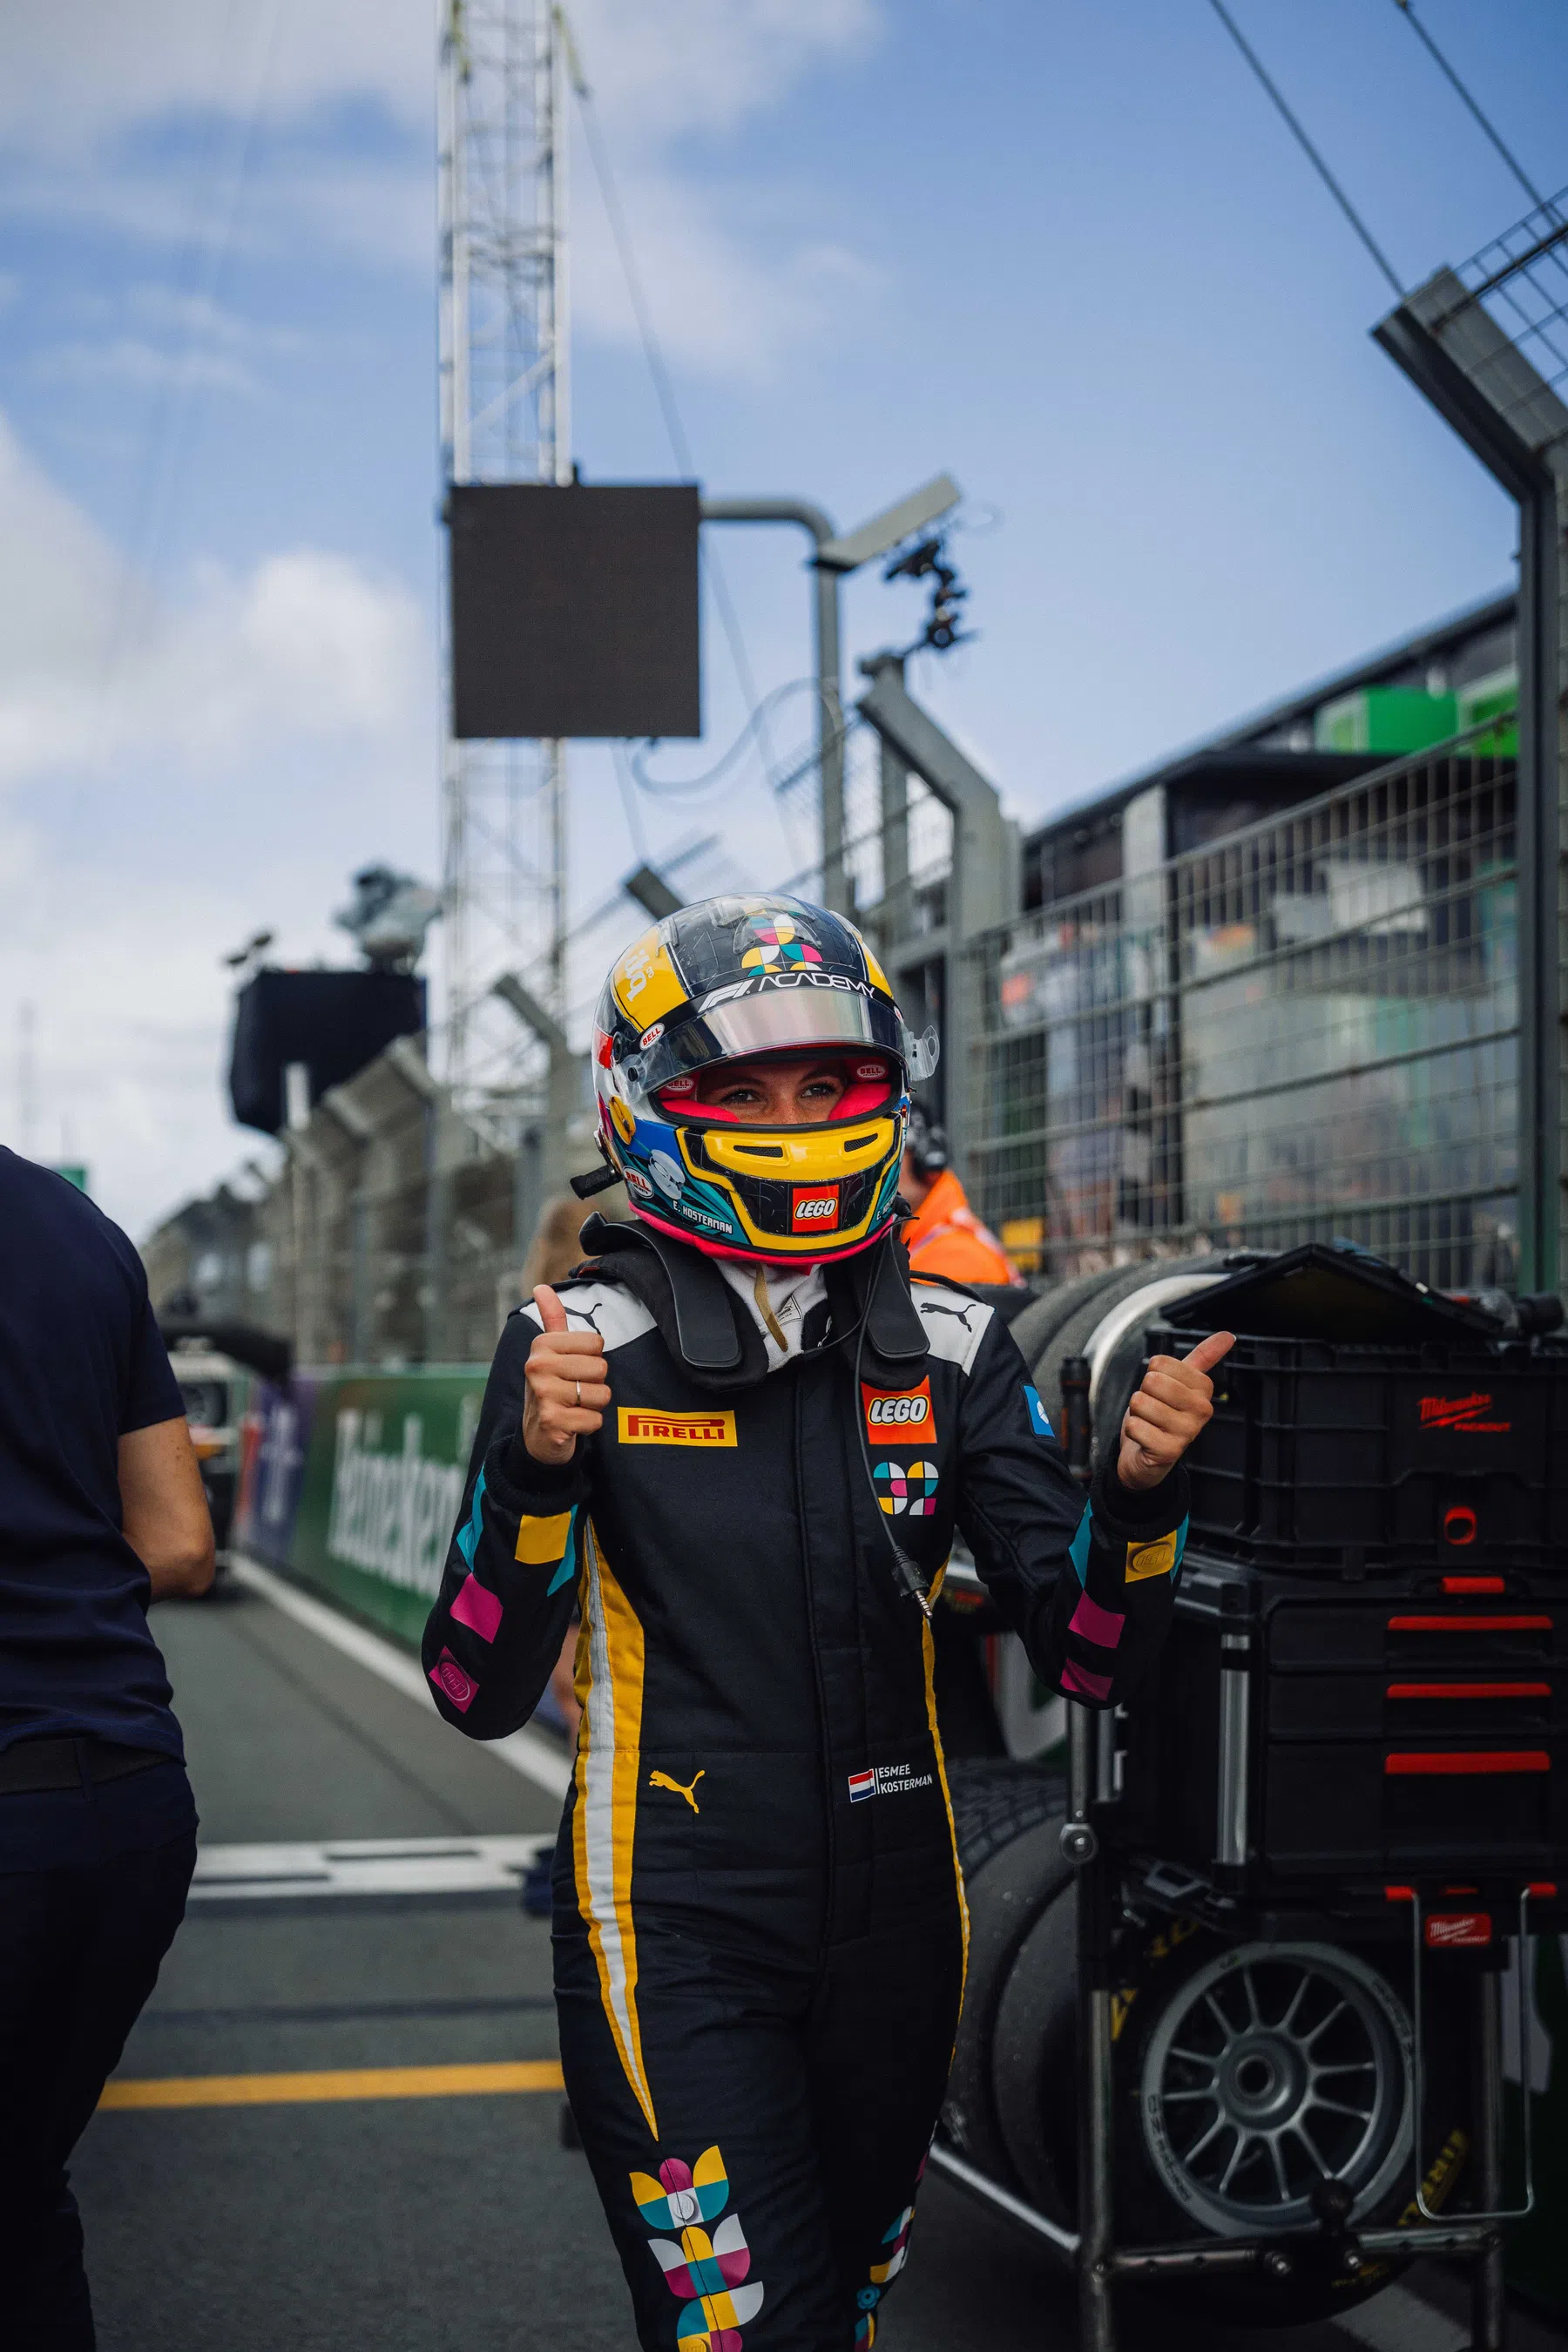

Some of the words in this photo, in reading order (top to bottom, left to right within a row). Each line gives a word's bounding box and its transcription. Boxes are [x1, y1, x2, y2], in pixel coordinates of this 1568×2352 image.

[758, 971, 875, 999] ACADEMY
[642, 1027, 661, 1046] BELL
[625, 1171, 652, 1193] BELL
[672, 1200, 681, 1213] E.
[794, 1198, 838, 1220] LEGO
[868, 1396, 929, 1426] LEGO
[627, 1415, 725, 1440] PIRELLI
[442, 1667, 467, 1696] LEGO
[878, 1763, 911, 1779] ESMEE
[880, 1774, 933, 1794] KOSTERMAN
